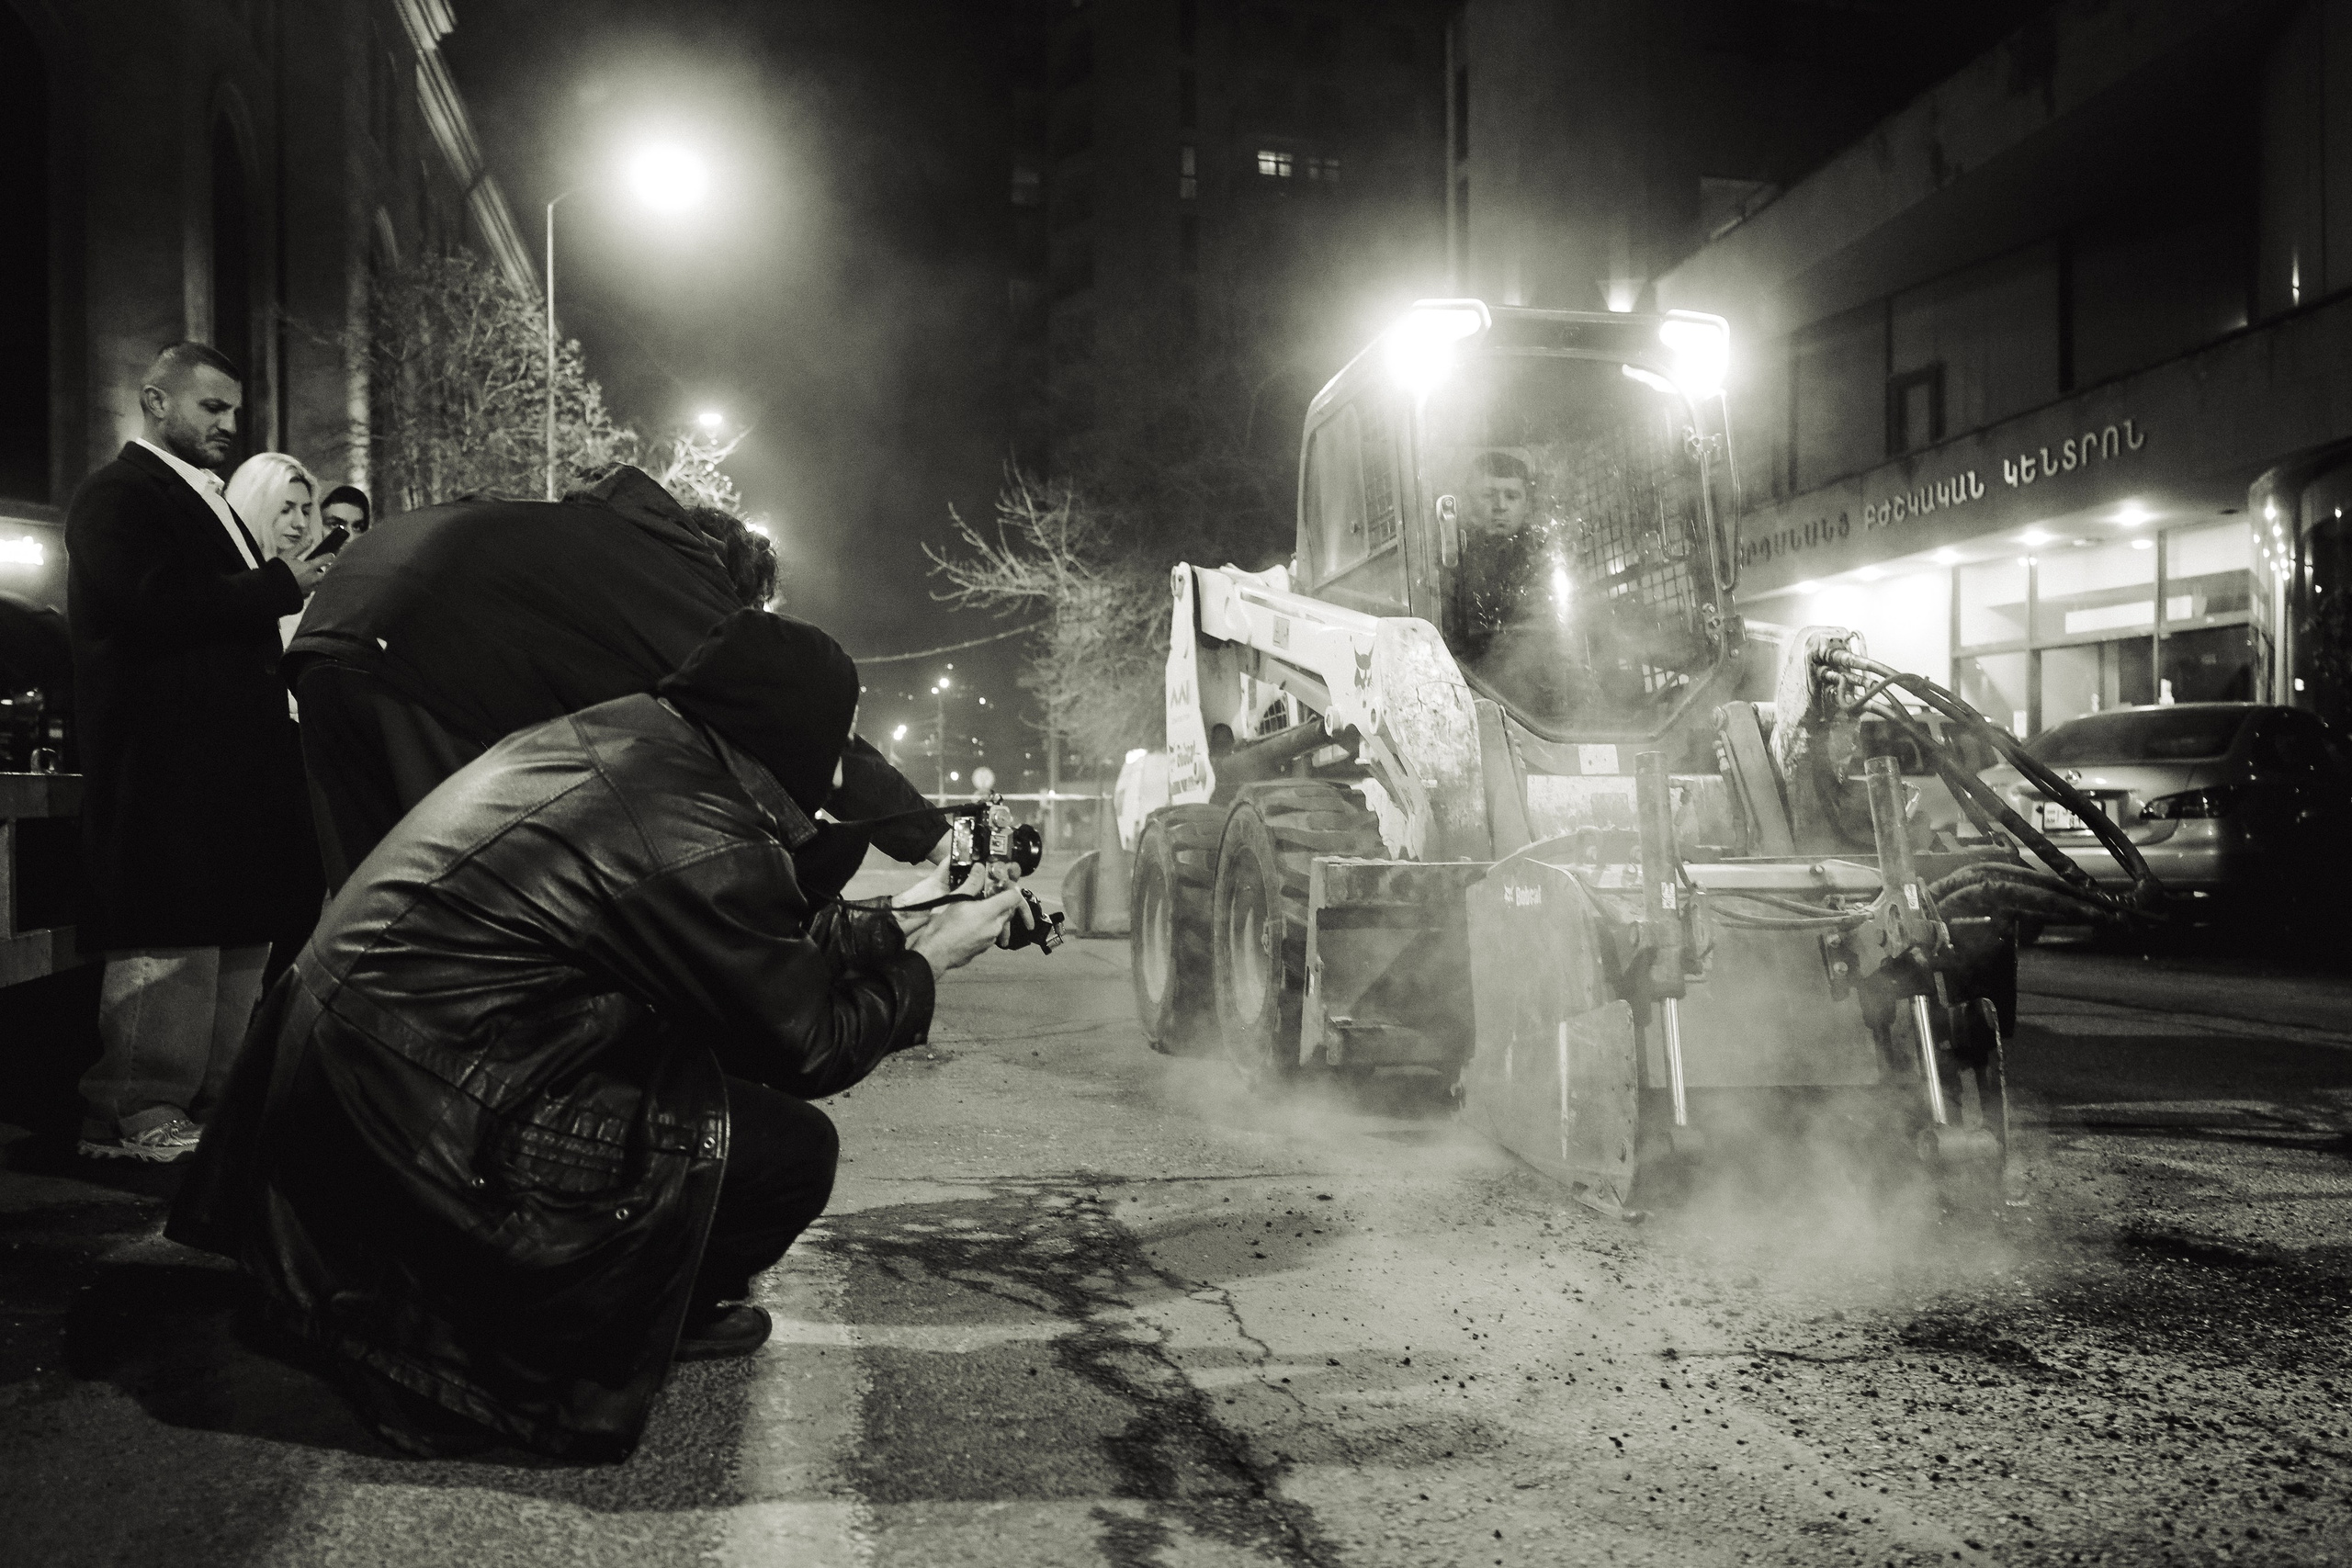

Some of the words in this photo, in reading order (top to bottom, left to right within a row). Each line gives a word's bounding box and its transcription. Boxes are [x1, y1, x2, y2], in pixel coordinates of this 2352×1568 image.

[1741, 512, 1850, 568] ՐԴԱՆԱՆՑ
[1864, 470, 1985, 530] ԲԺՇԿԱԿԱՆ
[2003, 419, 2145, 488] ԿԵՆՏՐՈՆ
[1516, 885, 1542, 907] Bobcat
